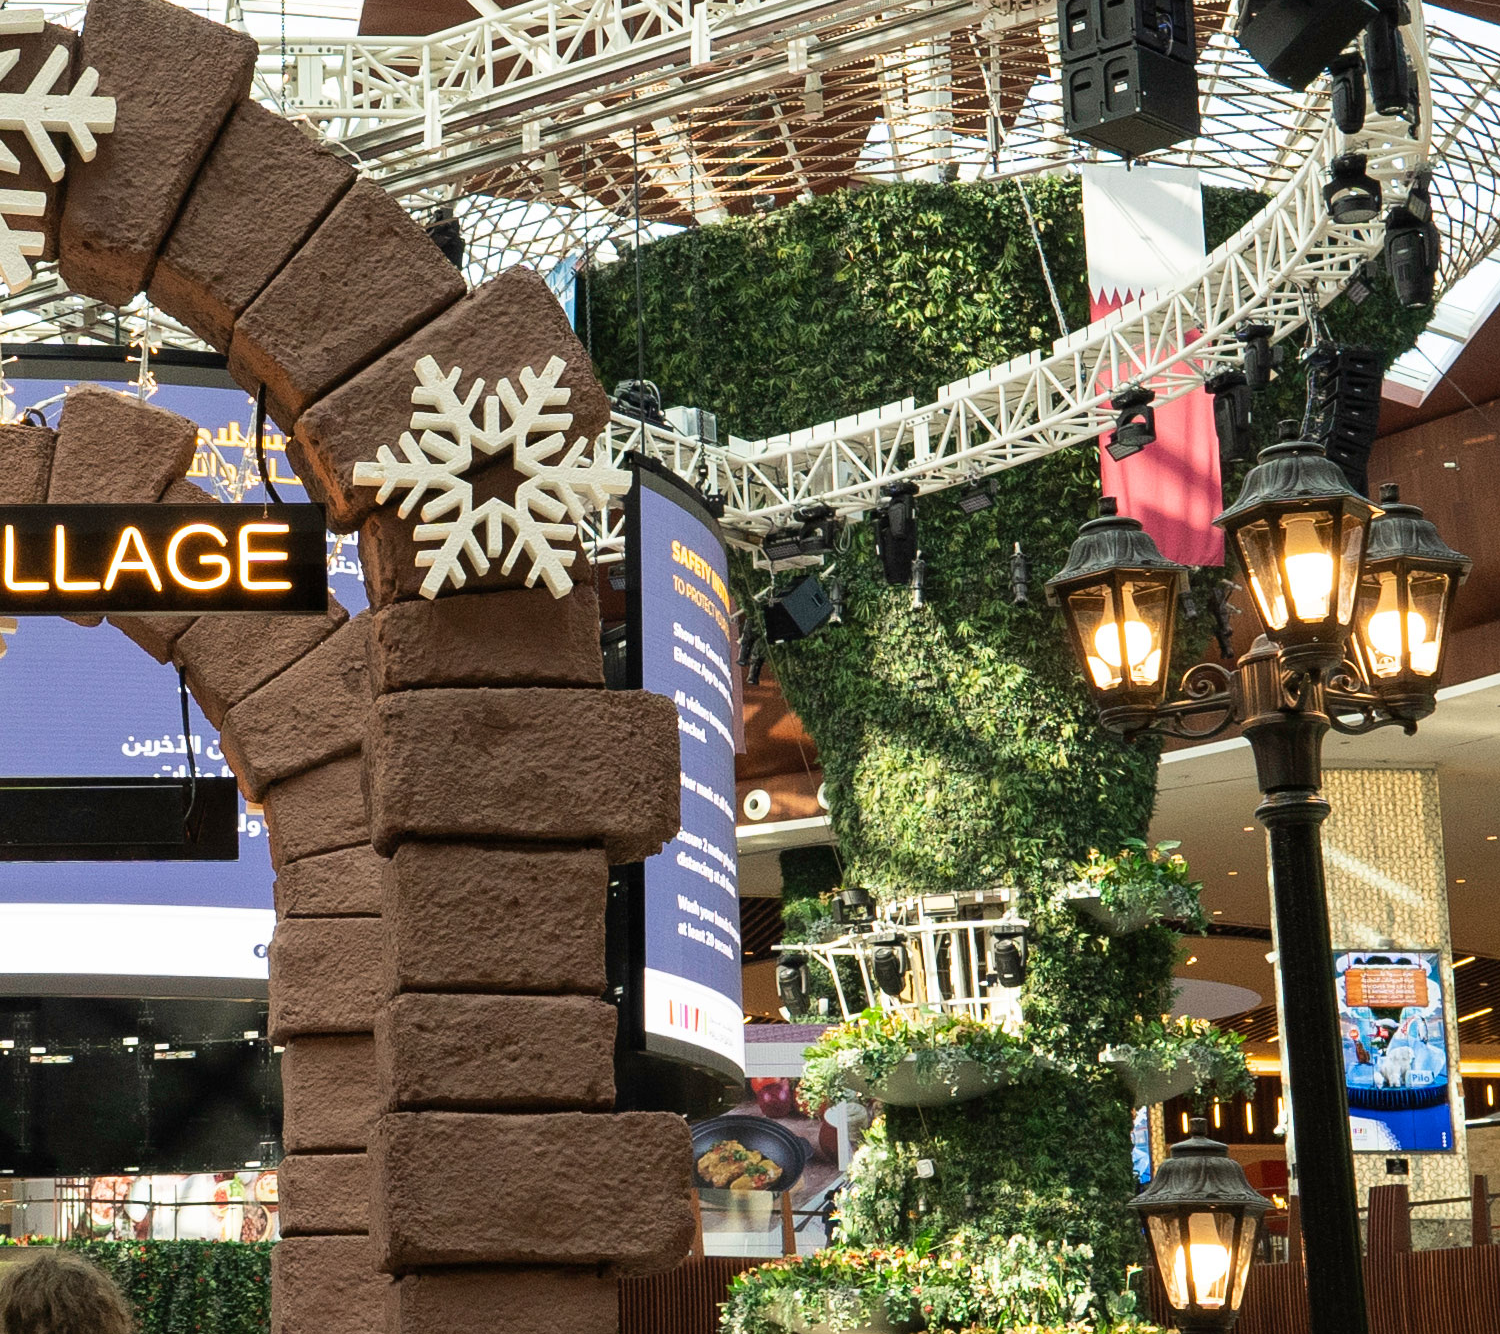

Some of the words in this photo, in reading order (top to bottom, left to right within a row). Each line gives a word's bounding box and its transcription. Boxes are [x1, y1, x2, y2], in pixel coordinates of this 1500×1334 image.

[671, 539, 712, 585] SAFETY
[672, 574, 686, 596] TO
[686, 583, 716, 617] PROTECT
[1412, 1073, 1430, 1083] Pilo
